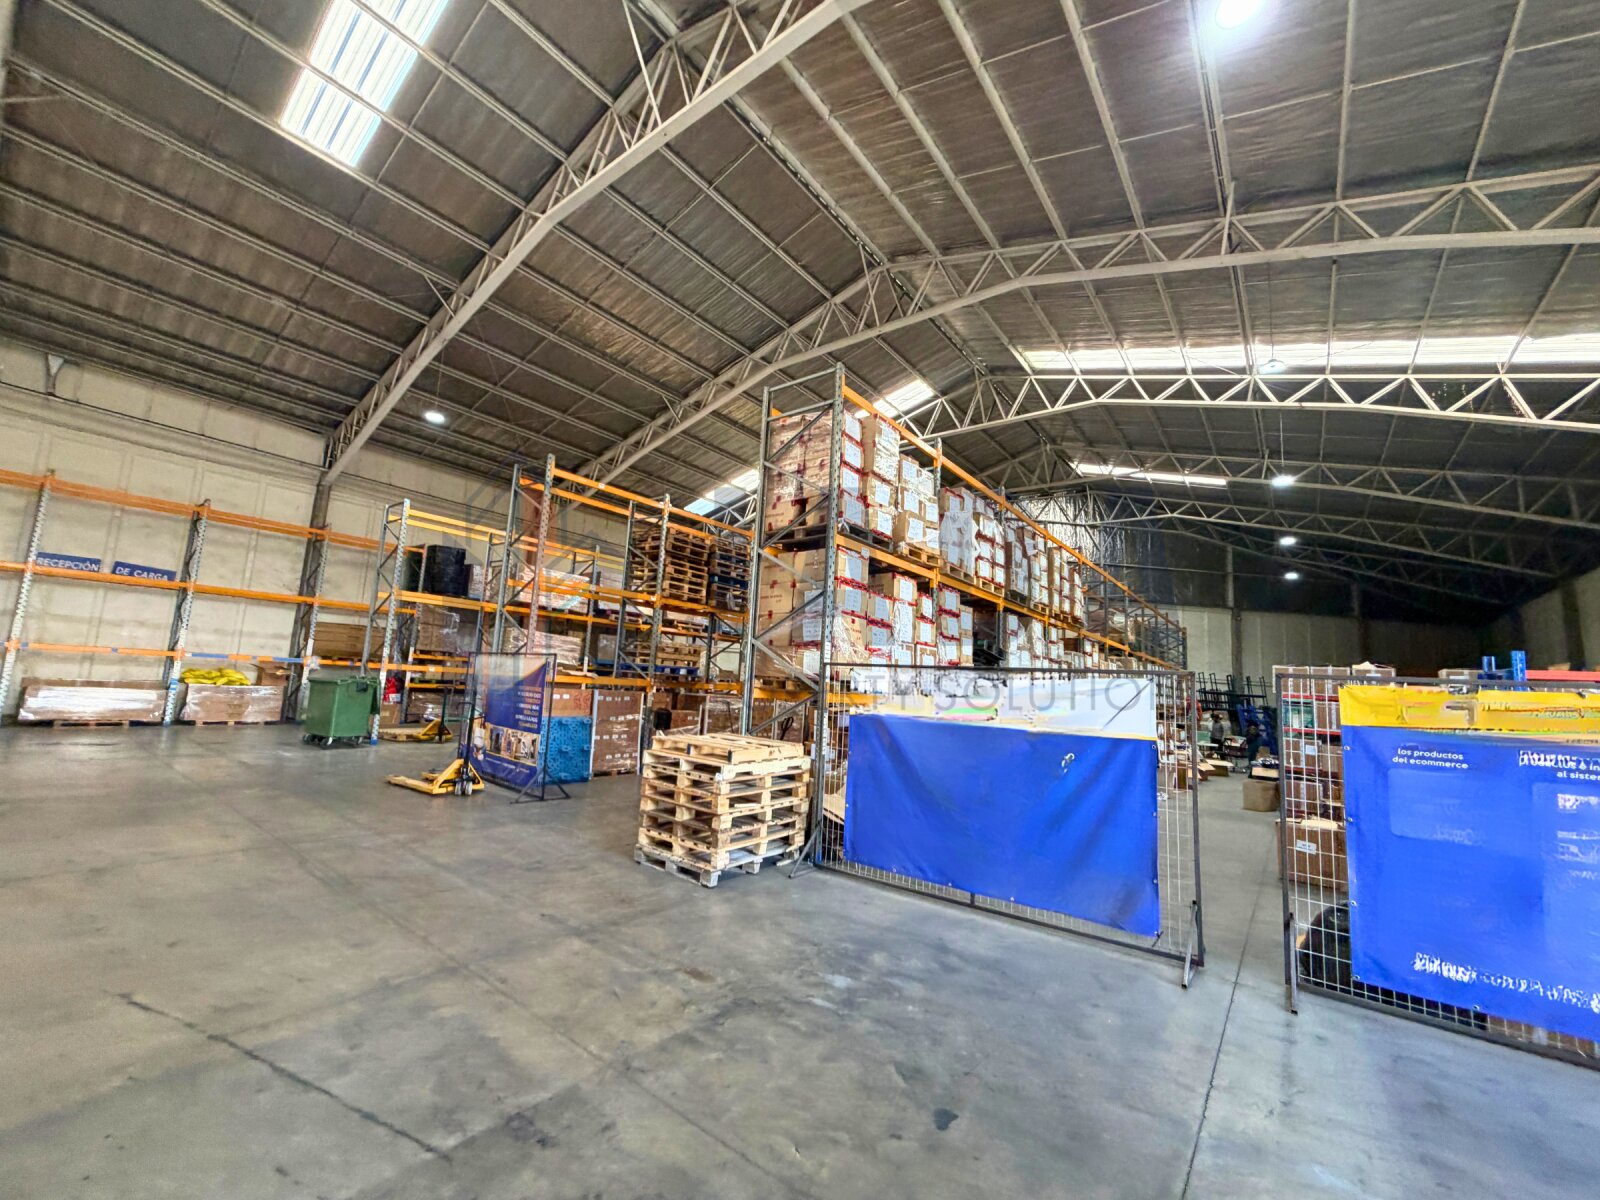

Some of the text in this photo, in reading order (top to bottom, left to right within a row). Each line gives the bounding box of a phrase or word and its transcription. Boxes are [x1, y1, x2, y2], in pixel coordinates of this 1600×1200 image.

[115, 566, 168, 580] DE CARGA
[1397, 747, 1464, 760] los productos
[1409, 758, 1469, 769] ecommerce
[1556, 770, 1567, 778] al
